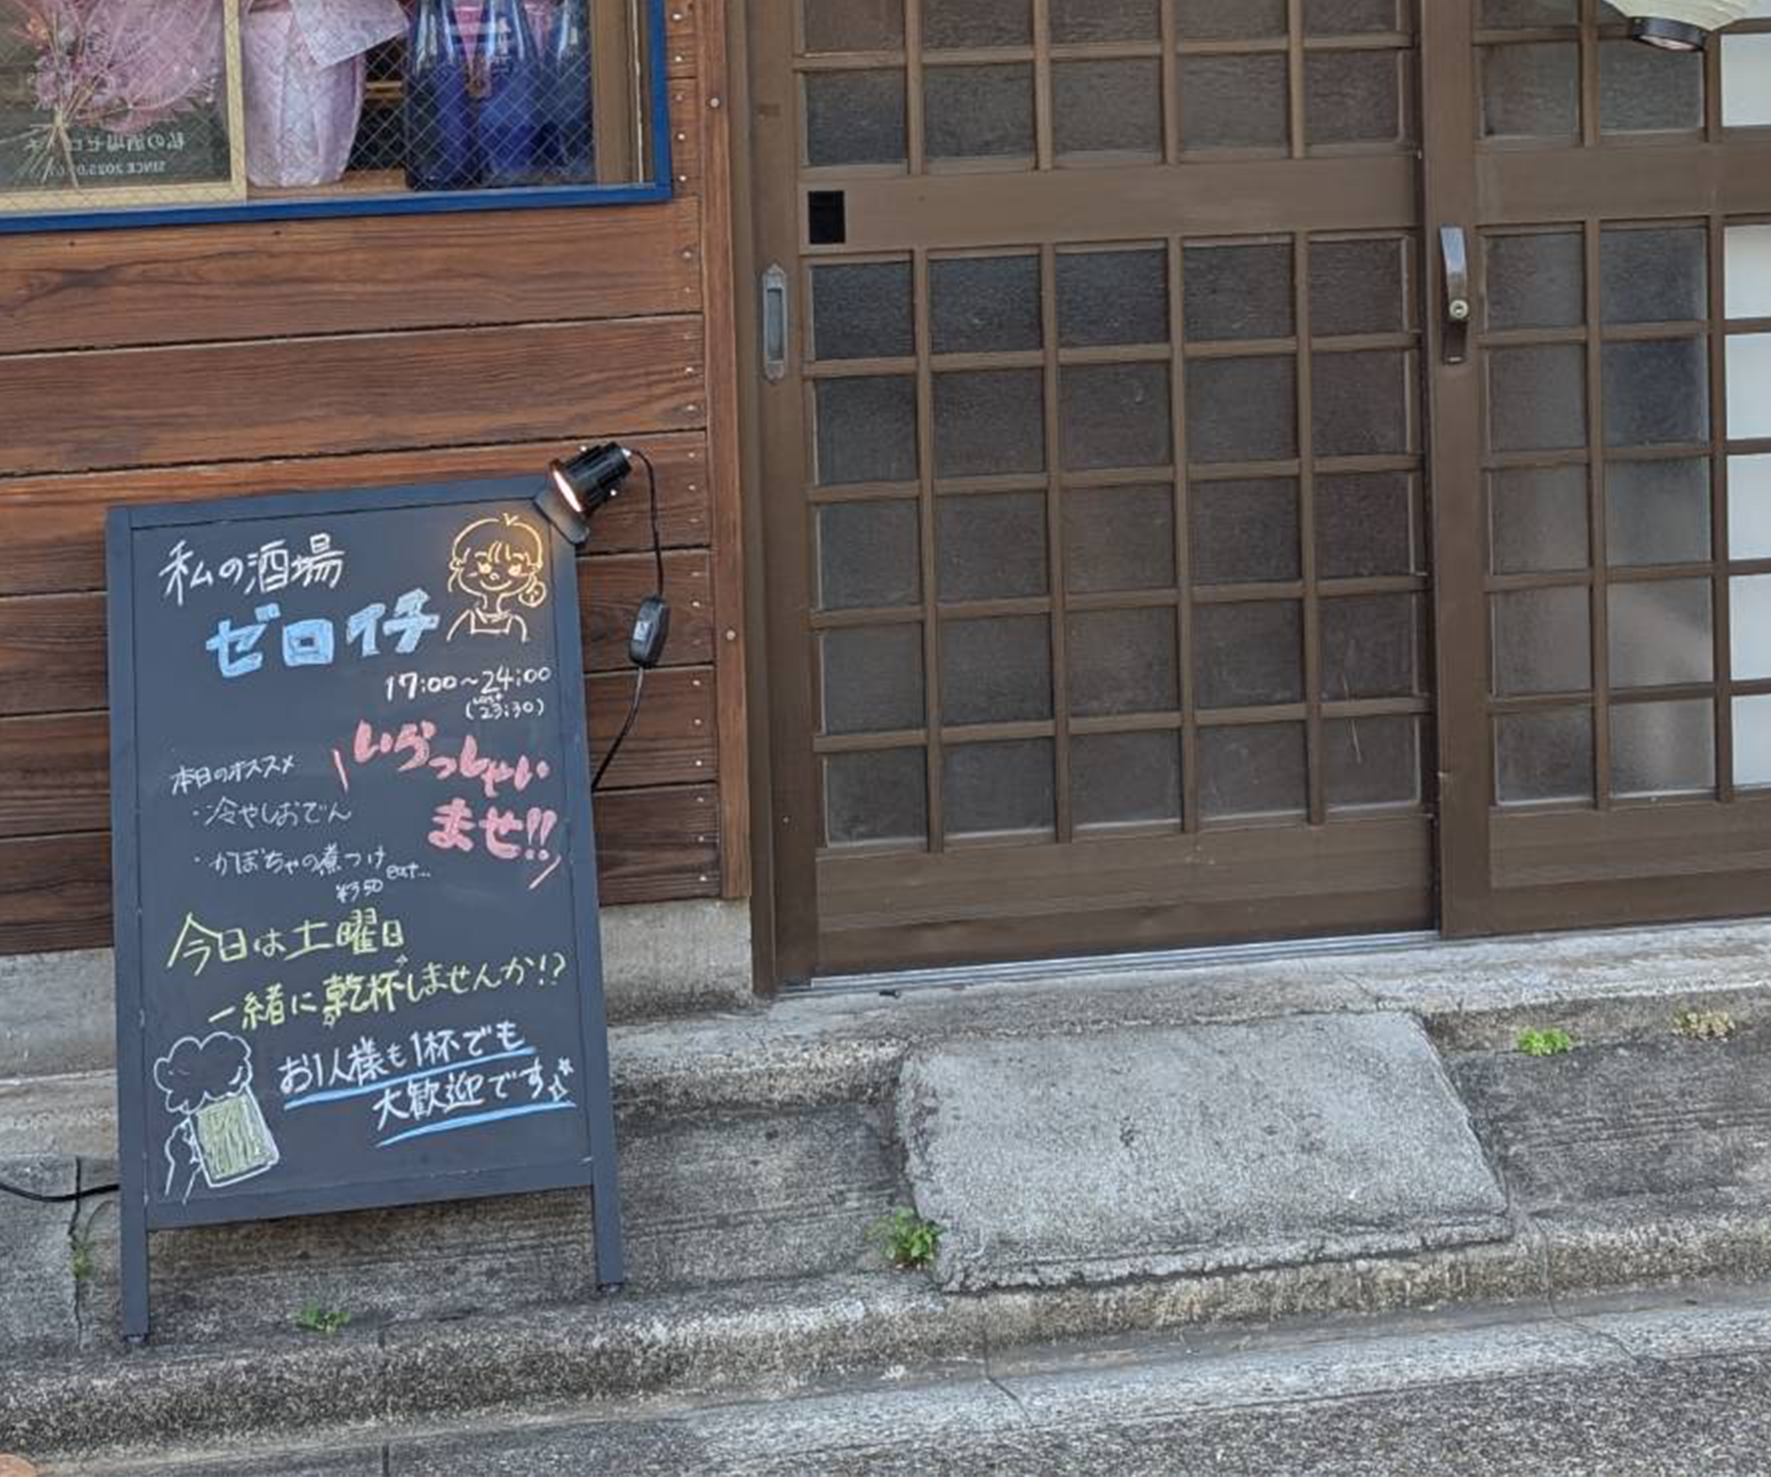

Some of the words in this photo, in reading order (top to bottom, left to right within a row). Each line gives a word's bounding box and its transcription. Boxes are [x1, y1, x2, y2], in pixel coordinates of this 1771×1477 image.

[159, 533, 345, 606] 私の酒場
[205, 588, 440, 678] ゼロイチ
[169, 754, 296, 795] 本日のオススメ
[353, 720, 550, 797] いらっしゃい
[167, 908, 404, 976] 今日は土曜日
[278, 1020, 525, 1094] お1人様も1杯でも
